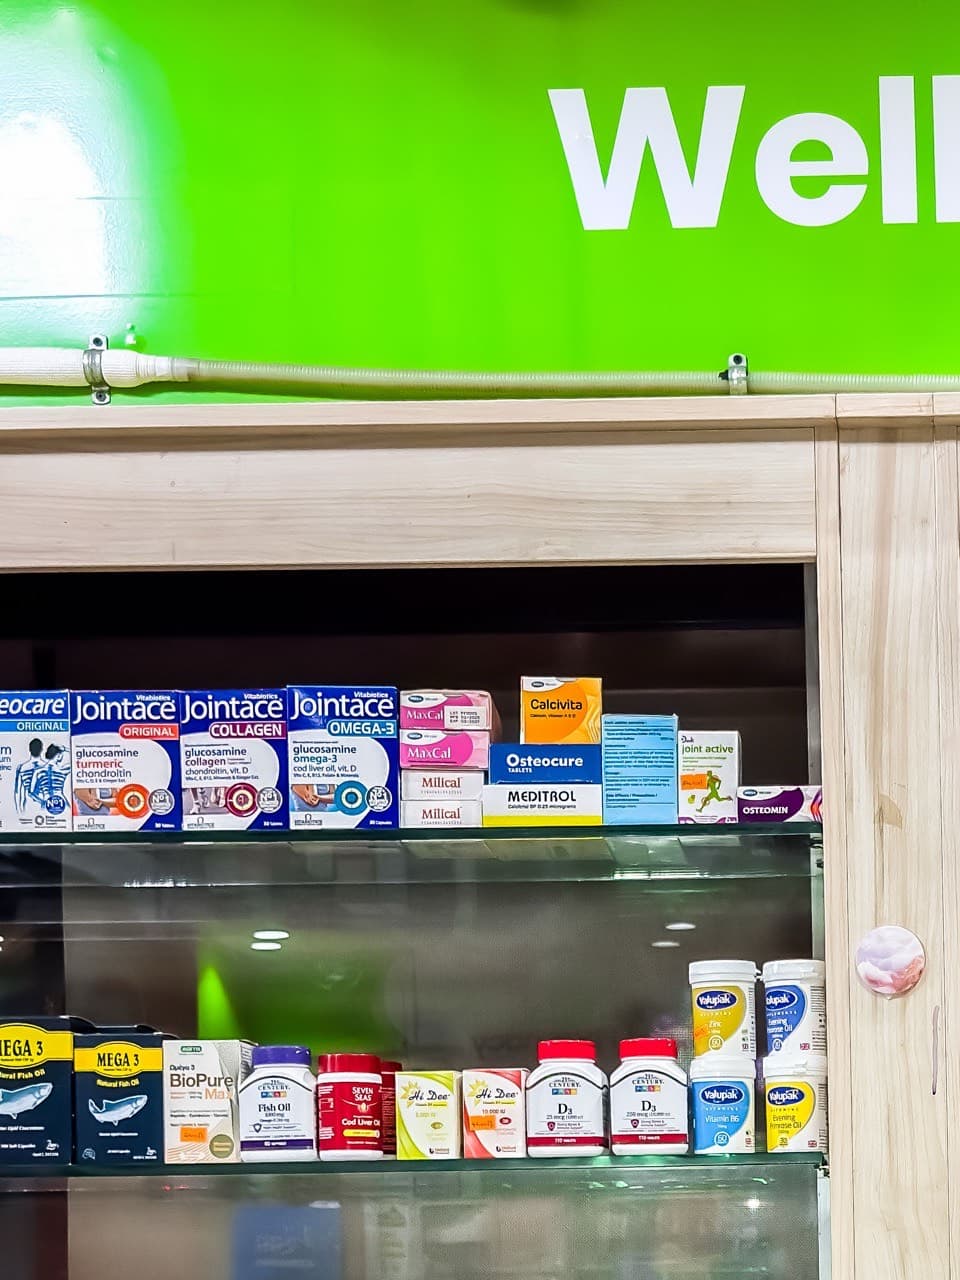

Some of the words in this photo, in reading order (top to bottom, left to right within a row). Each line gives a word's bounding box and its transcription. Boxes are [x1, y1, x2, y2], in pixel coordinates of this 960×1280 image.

[73, 695, 176, 724] Jointace
[181, 695, 282, 723] Jointace
[290, 692, 394, 720] Jointace
[530, 699, 583, 711] Calcivita
[16, 722, 65, 732] ORIGINAL
[123, 726, 175, 737] ORIGINAL
[211, 724, 282, 736] COLLAGEN
[330, 722, 395, 735] OMEGA-3
[76, 749, 139, 759] glucosamine
[185, 747, 247, 758] glucosamine
[293, 745, 356, 755] glucosamine
[408, 747, 451, 759] MaxCal
[682, 744, 702, 755] joint
[705, 744, 734, 753] active
[76, 759, 123, 769] turmeric
[185, 757, 226, 767] collagen
[293, 755, 337, 764] omega-3
[507, 754, 583, 769] Osteocure
[76, 769, 132, 778] chondroitin
[422, 777, 460, 789] Milical
[508, 791, 576, 802] MEDITROL
[743, 806, 788, 815] OSTEOMIN
[97, 1052, 121, 1067] MEGA
[131, 1054, 139, 1067] 3
[169, 1073, 233, 1088] BioPure
[204, 1088, 233, 1099] Max
[352, 1086, 374, 1094] SEVEN
[705, 1090, 738, 1103] Valupak
[258, 1103, 277, 1113] Fish
[279, 1102, 291, 1112] Oil
